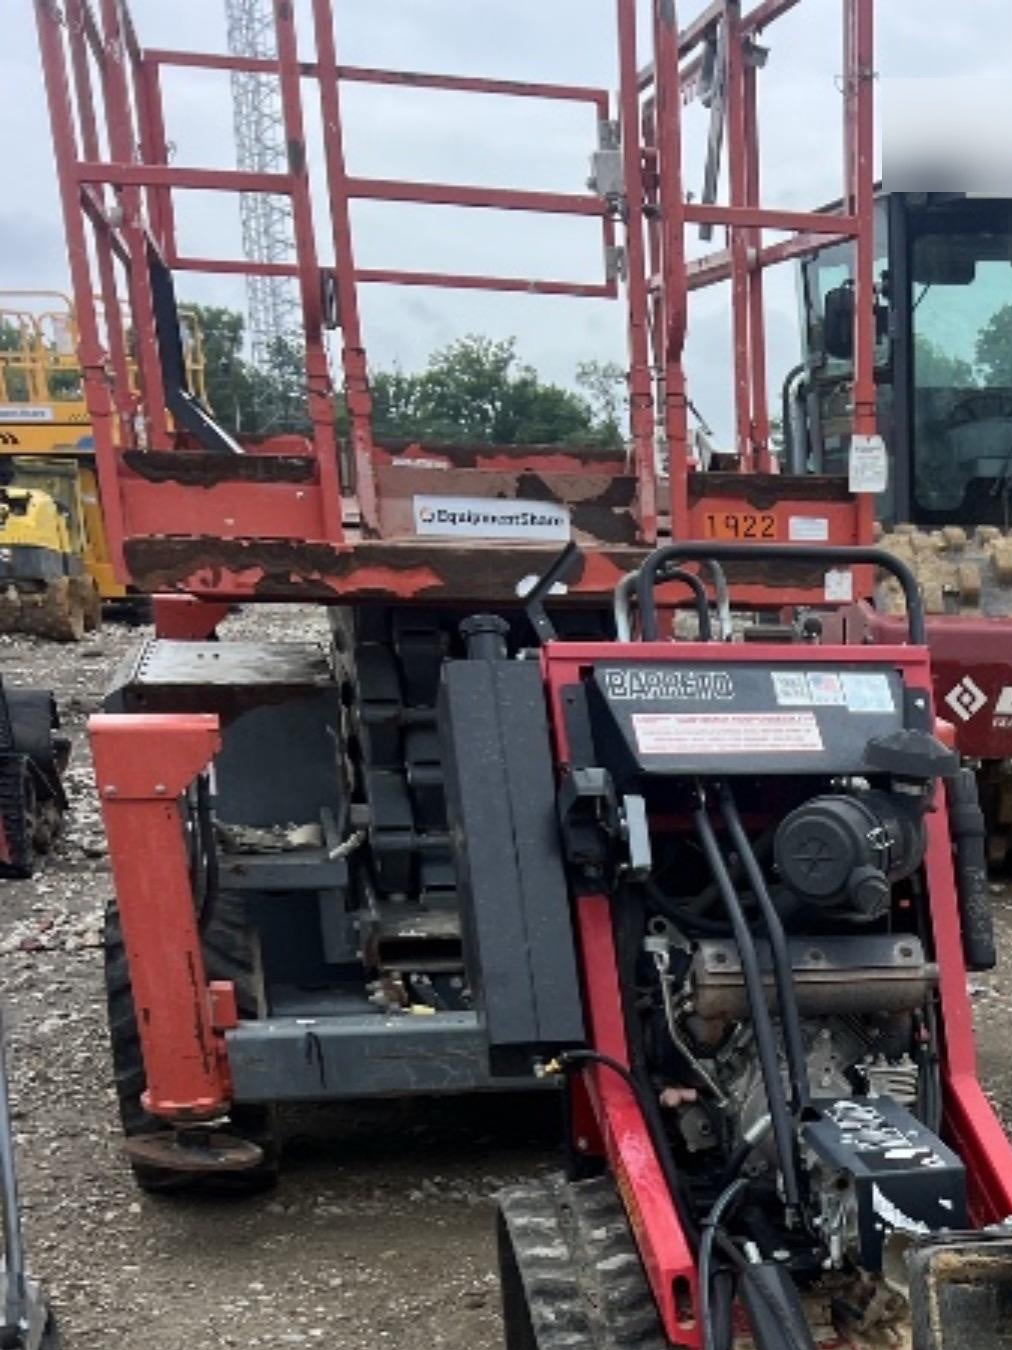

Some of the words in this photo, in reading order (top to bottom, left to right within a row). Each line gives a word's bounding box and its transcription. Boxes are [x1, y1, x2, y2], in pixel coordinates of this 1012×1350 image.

[437, 508, 565, 526] EquipmentShare
[707, 515, 774, 538] 1922
[604, 668, 735, 700] BARRETO
